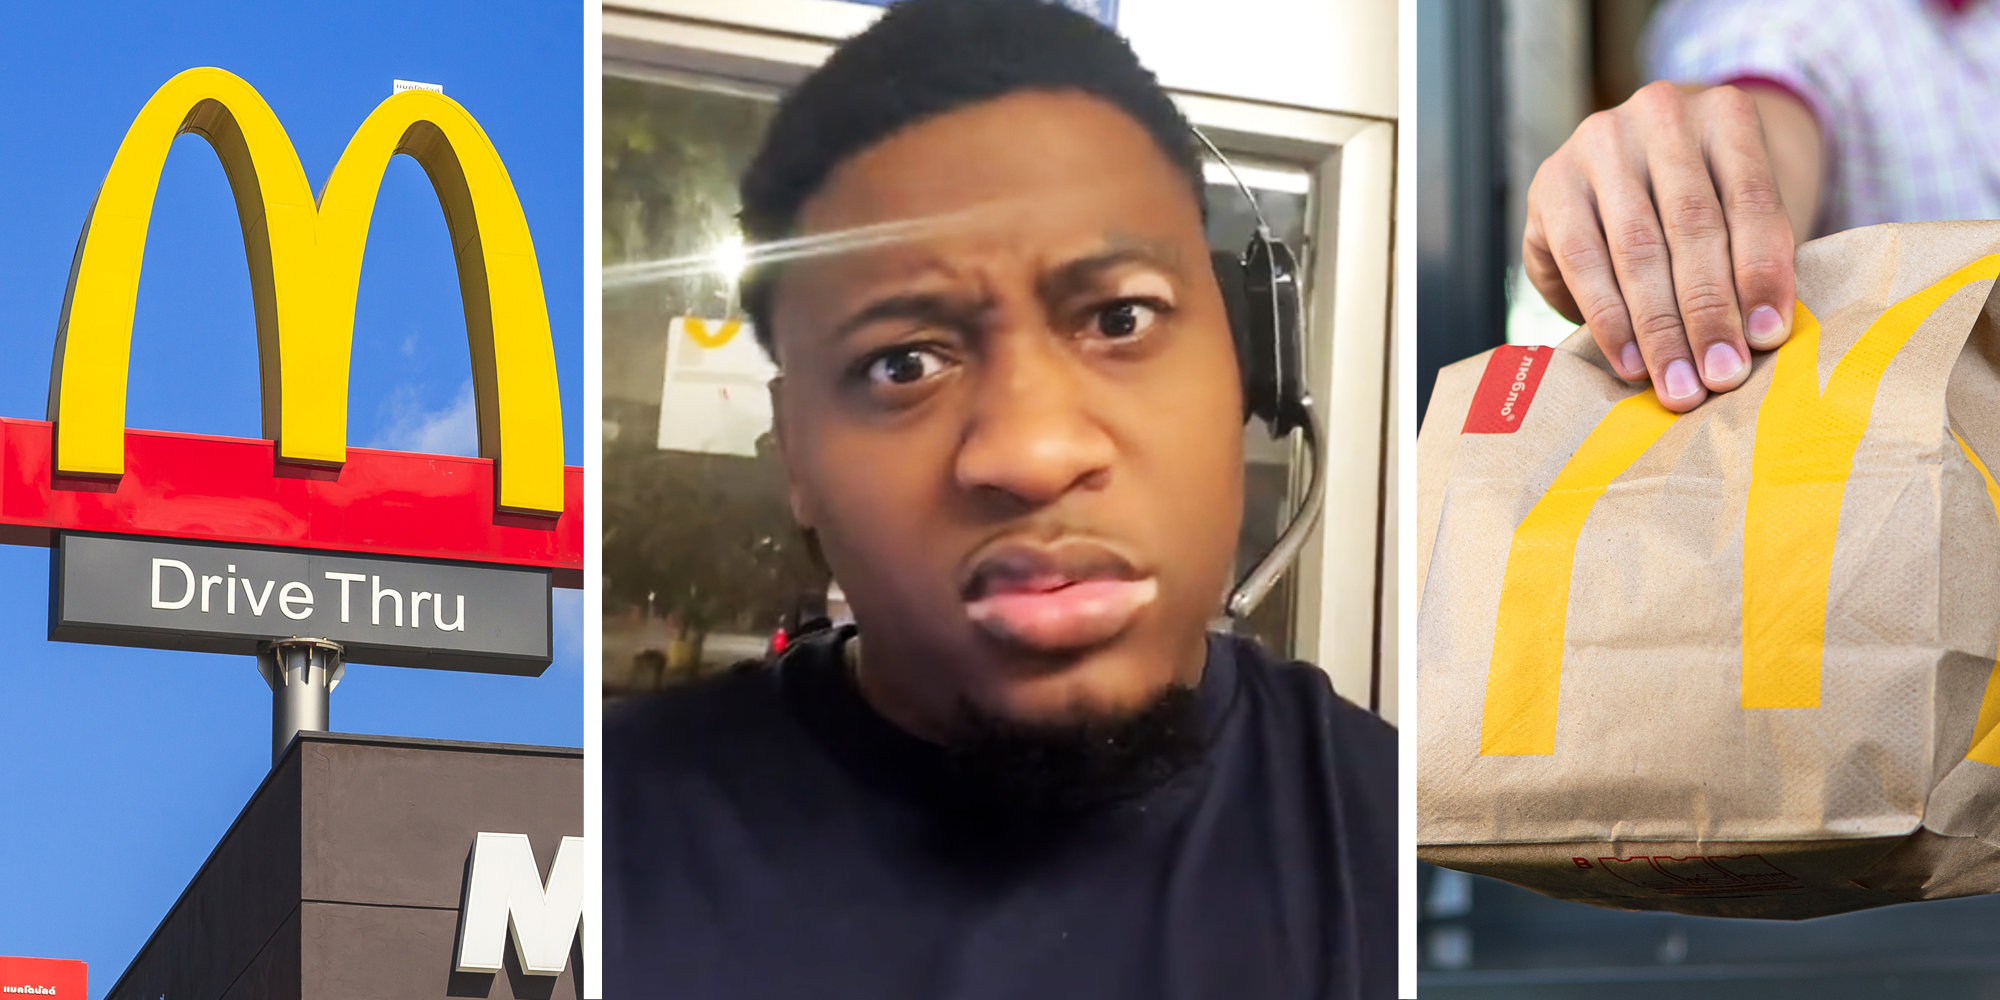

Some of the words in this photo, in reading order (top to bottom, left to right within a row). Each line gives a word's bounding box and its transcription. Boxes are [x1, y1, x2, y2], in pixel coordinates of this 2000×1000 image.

[151, 557, 315, 620] Drive
[324, 570, 466, 632] Thru
[457, 832, 584, 976] M
